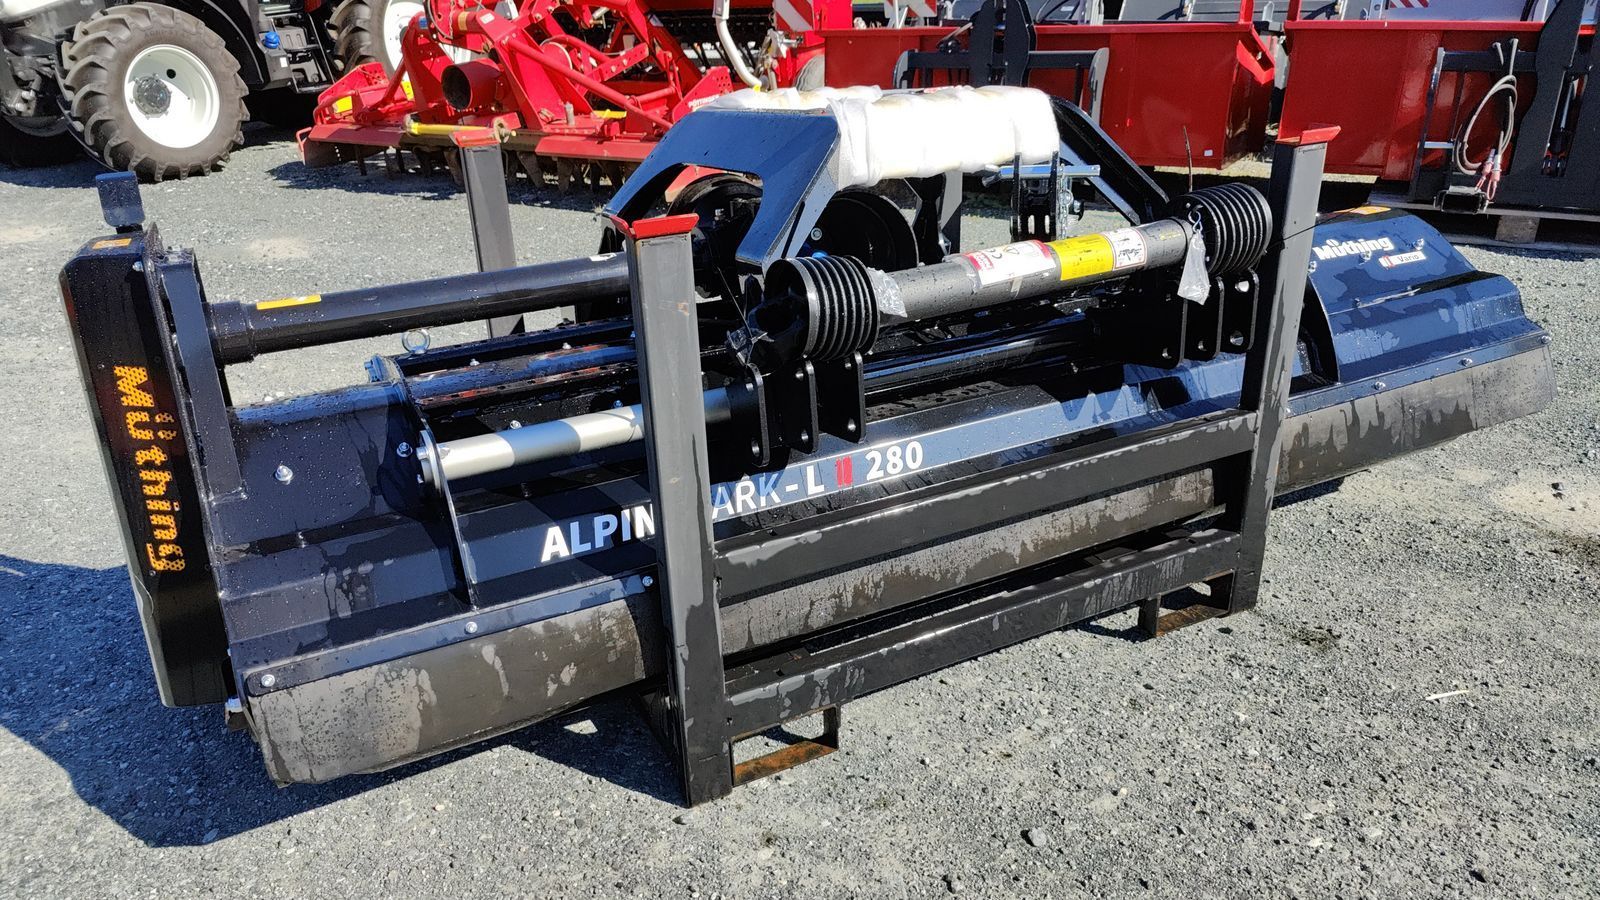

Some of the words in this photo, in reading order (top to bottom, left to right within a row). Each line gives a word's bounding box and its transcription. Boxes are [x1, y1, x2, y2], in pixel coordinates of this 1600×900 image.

[1312, 237, 1395, 261] Müthing
[1396, 253, 1420, 263] Vario
[113, 366, 186, 571] Müthing
[865, 441, 924, 482] 280
